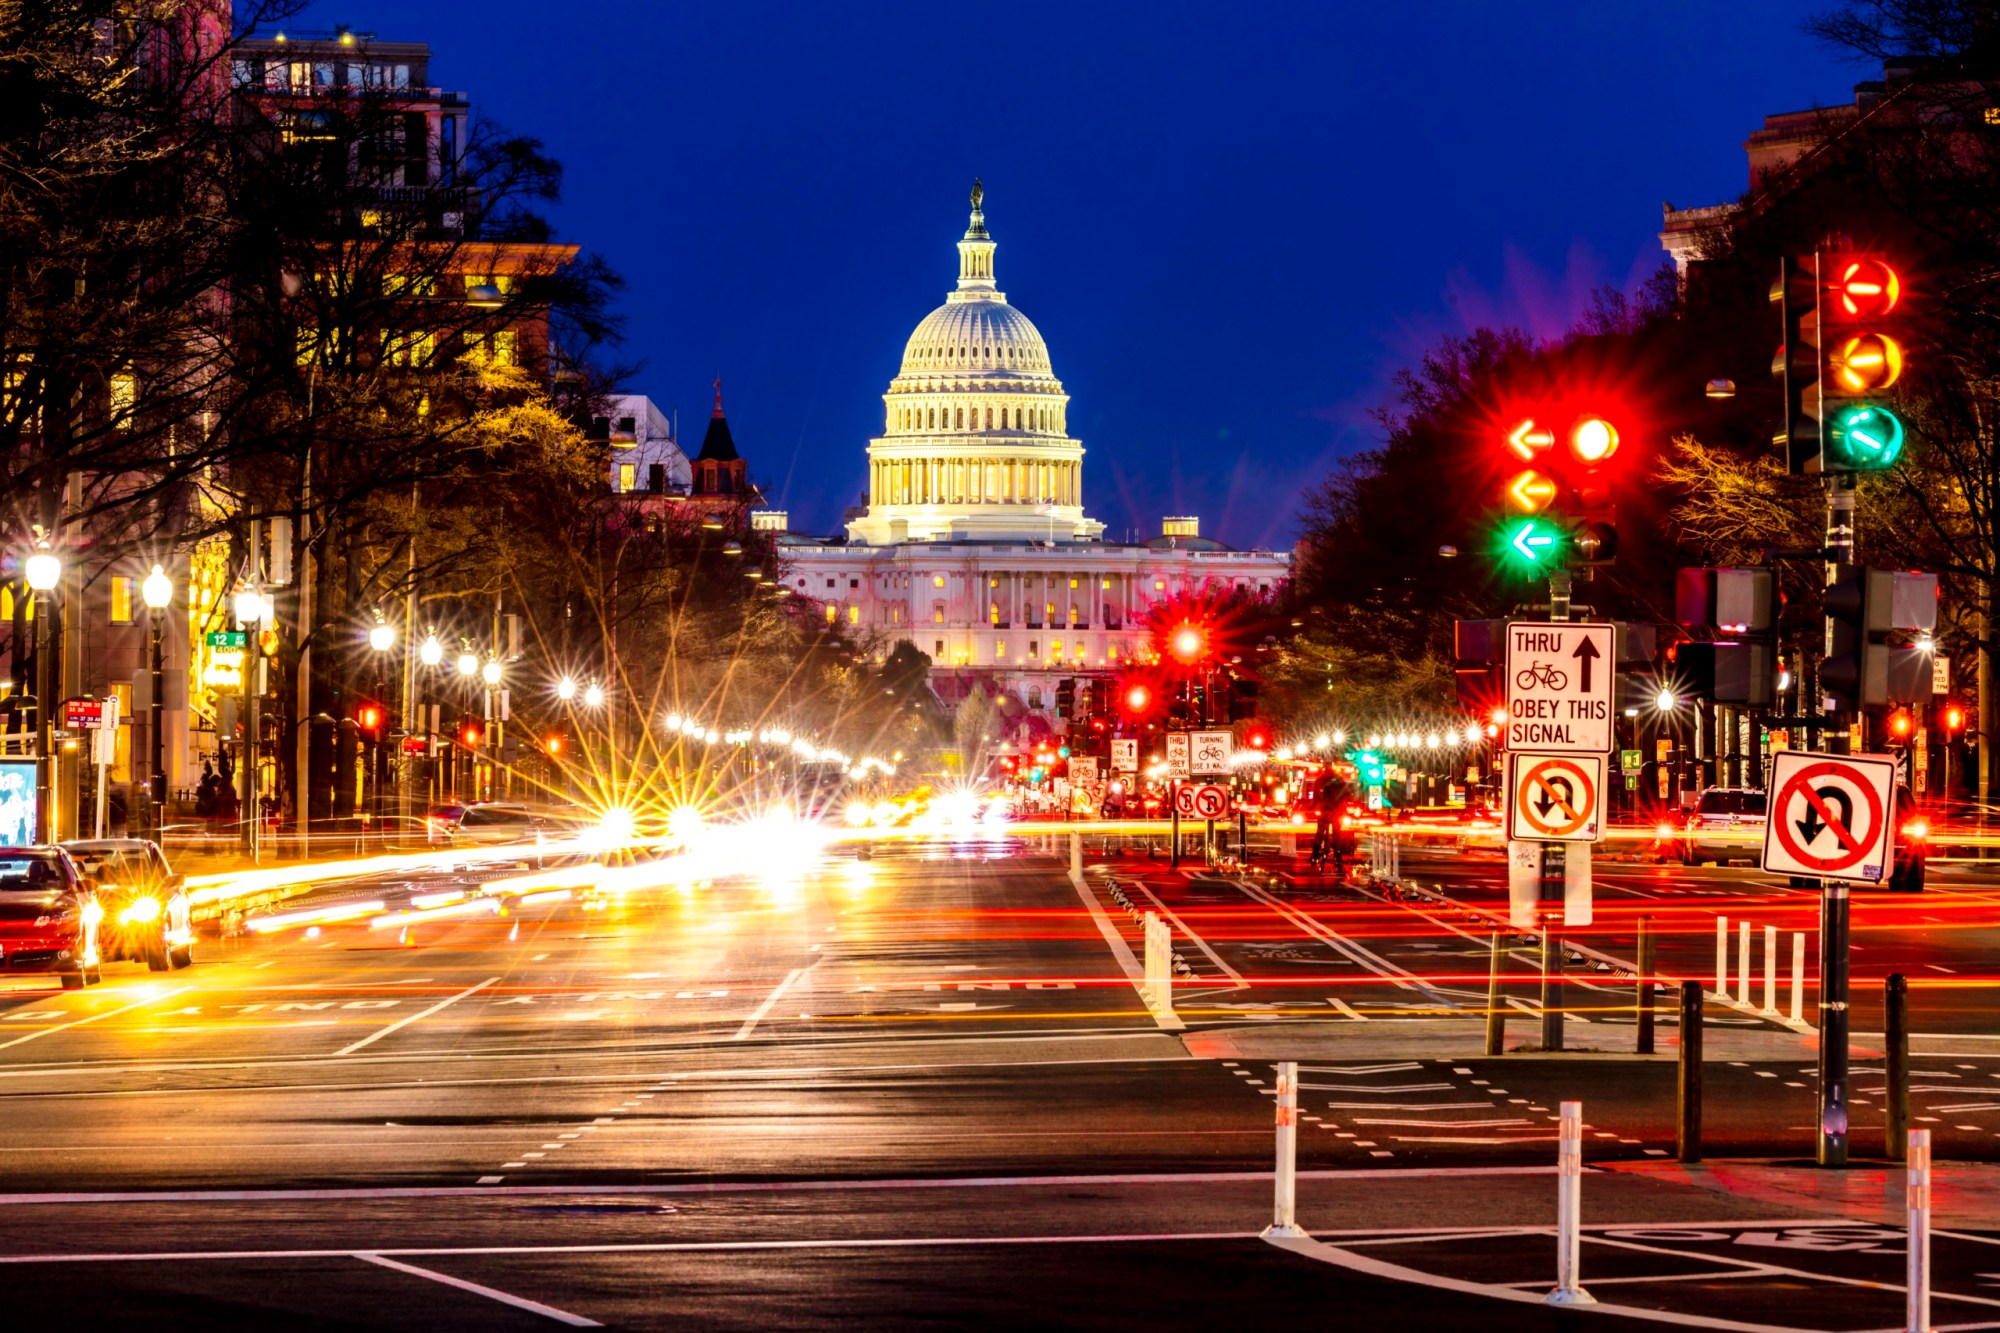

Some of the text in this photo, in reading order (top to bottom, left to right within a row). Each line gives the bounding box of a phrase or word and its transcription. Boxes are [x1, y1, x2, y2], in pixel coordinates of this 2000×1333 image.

[213, 634, 228, 645] 12
[1515, 632, 1562, 653] THRU
[1512, 698, 1607, 720] OBEY THIS
[1512, 723, 1576, 744] SIGNAL
[1169, 736, 1186, 745] THRU
[1199, 736, 1224, 744] TURNING
[1168, 759, 1185, 768] OBEY
[1192, 762, 1204, 770] USE
